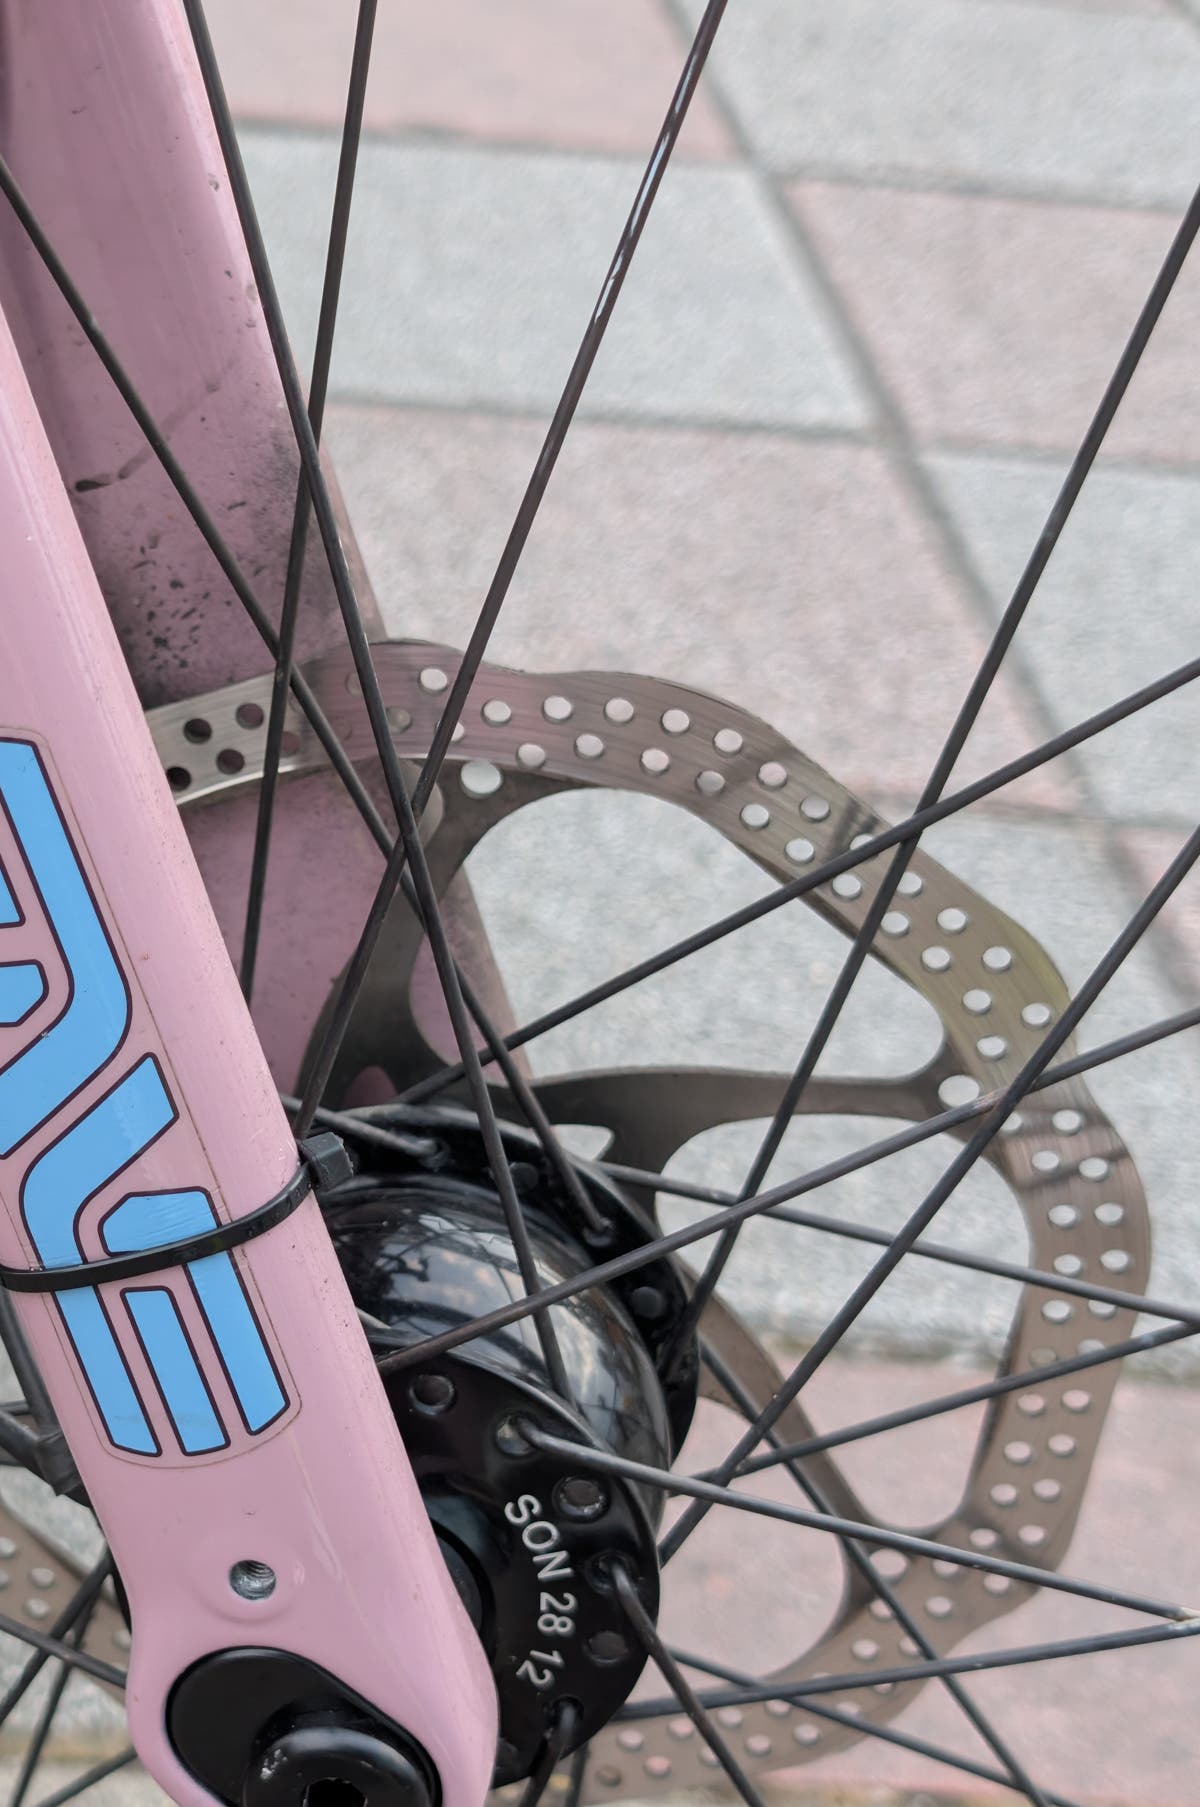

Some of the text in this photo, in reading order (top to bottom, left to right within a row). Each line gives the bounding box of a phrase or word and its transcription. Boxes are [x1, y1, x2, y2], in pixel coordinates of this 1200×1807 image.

[504, 1494, 577, 1688] SON 28 12
